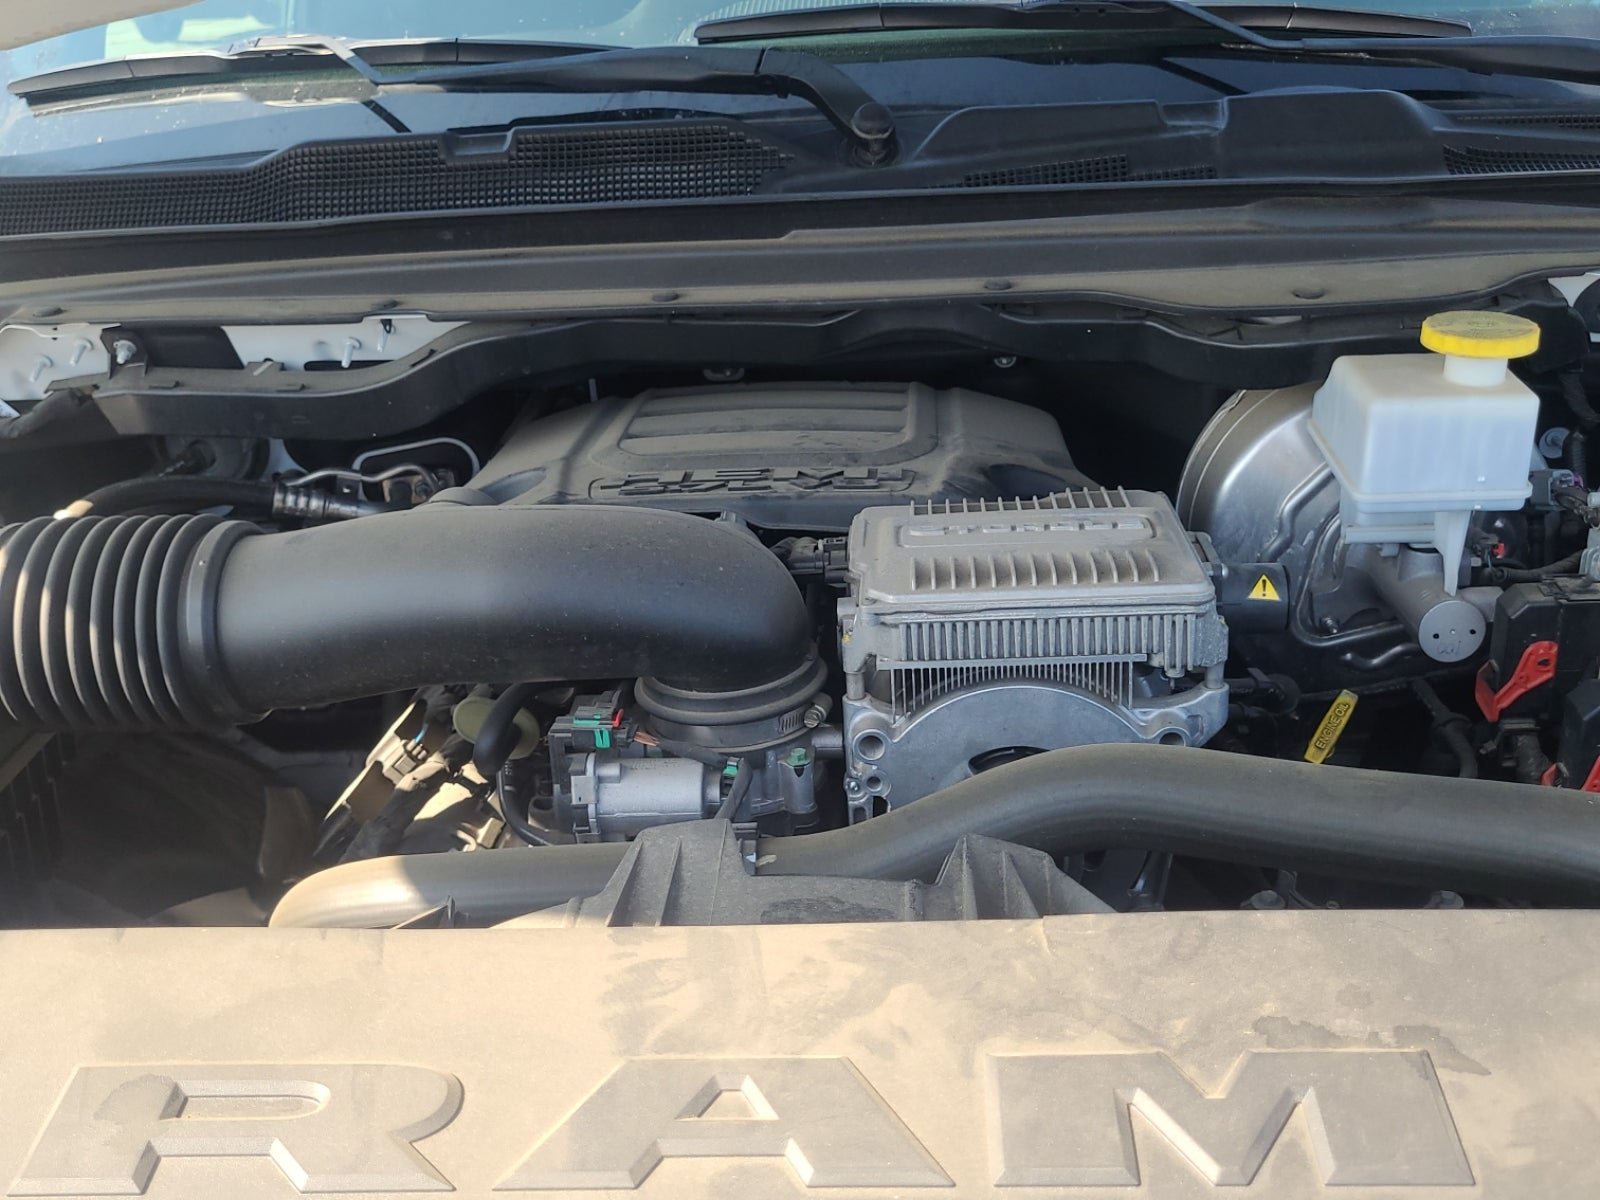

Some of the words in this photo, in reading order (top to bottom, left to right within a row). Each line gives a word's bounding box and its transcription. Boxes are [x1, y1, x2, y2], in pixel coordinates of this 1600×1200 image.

[1315, 714, 1341, 749] ENGINE
[1334, 703, 1349, 717] OIL
[7, 1050, 1478, 1196] RAM
